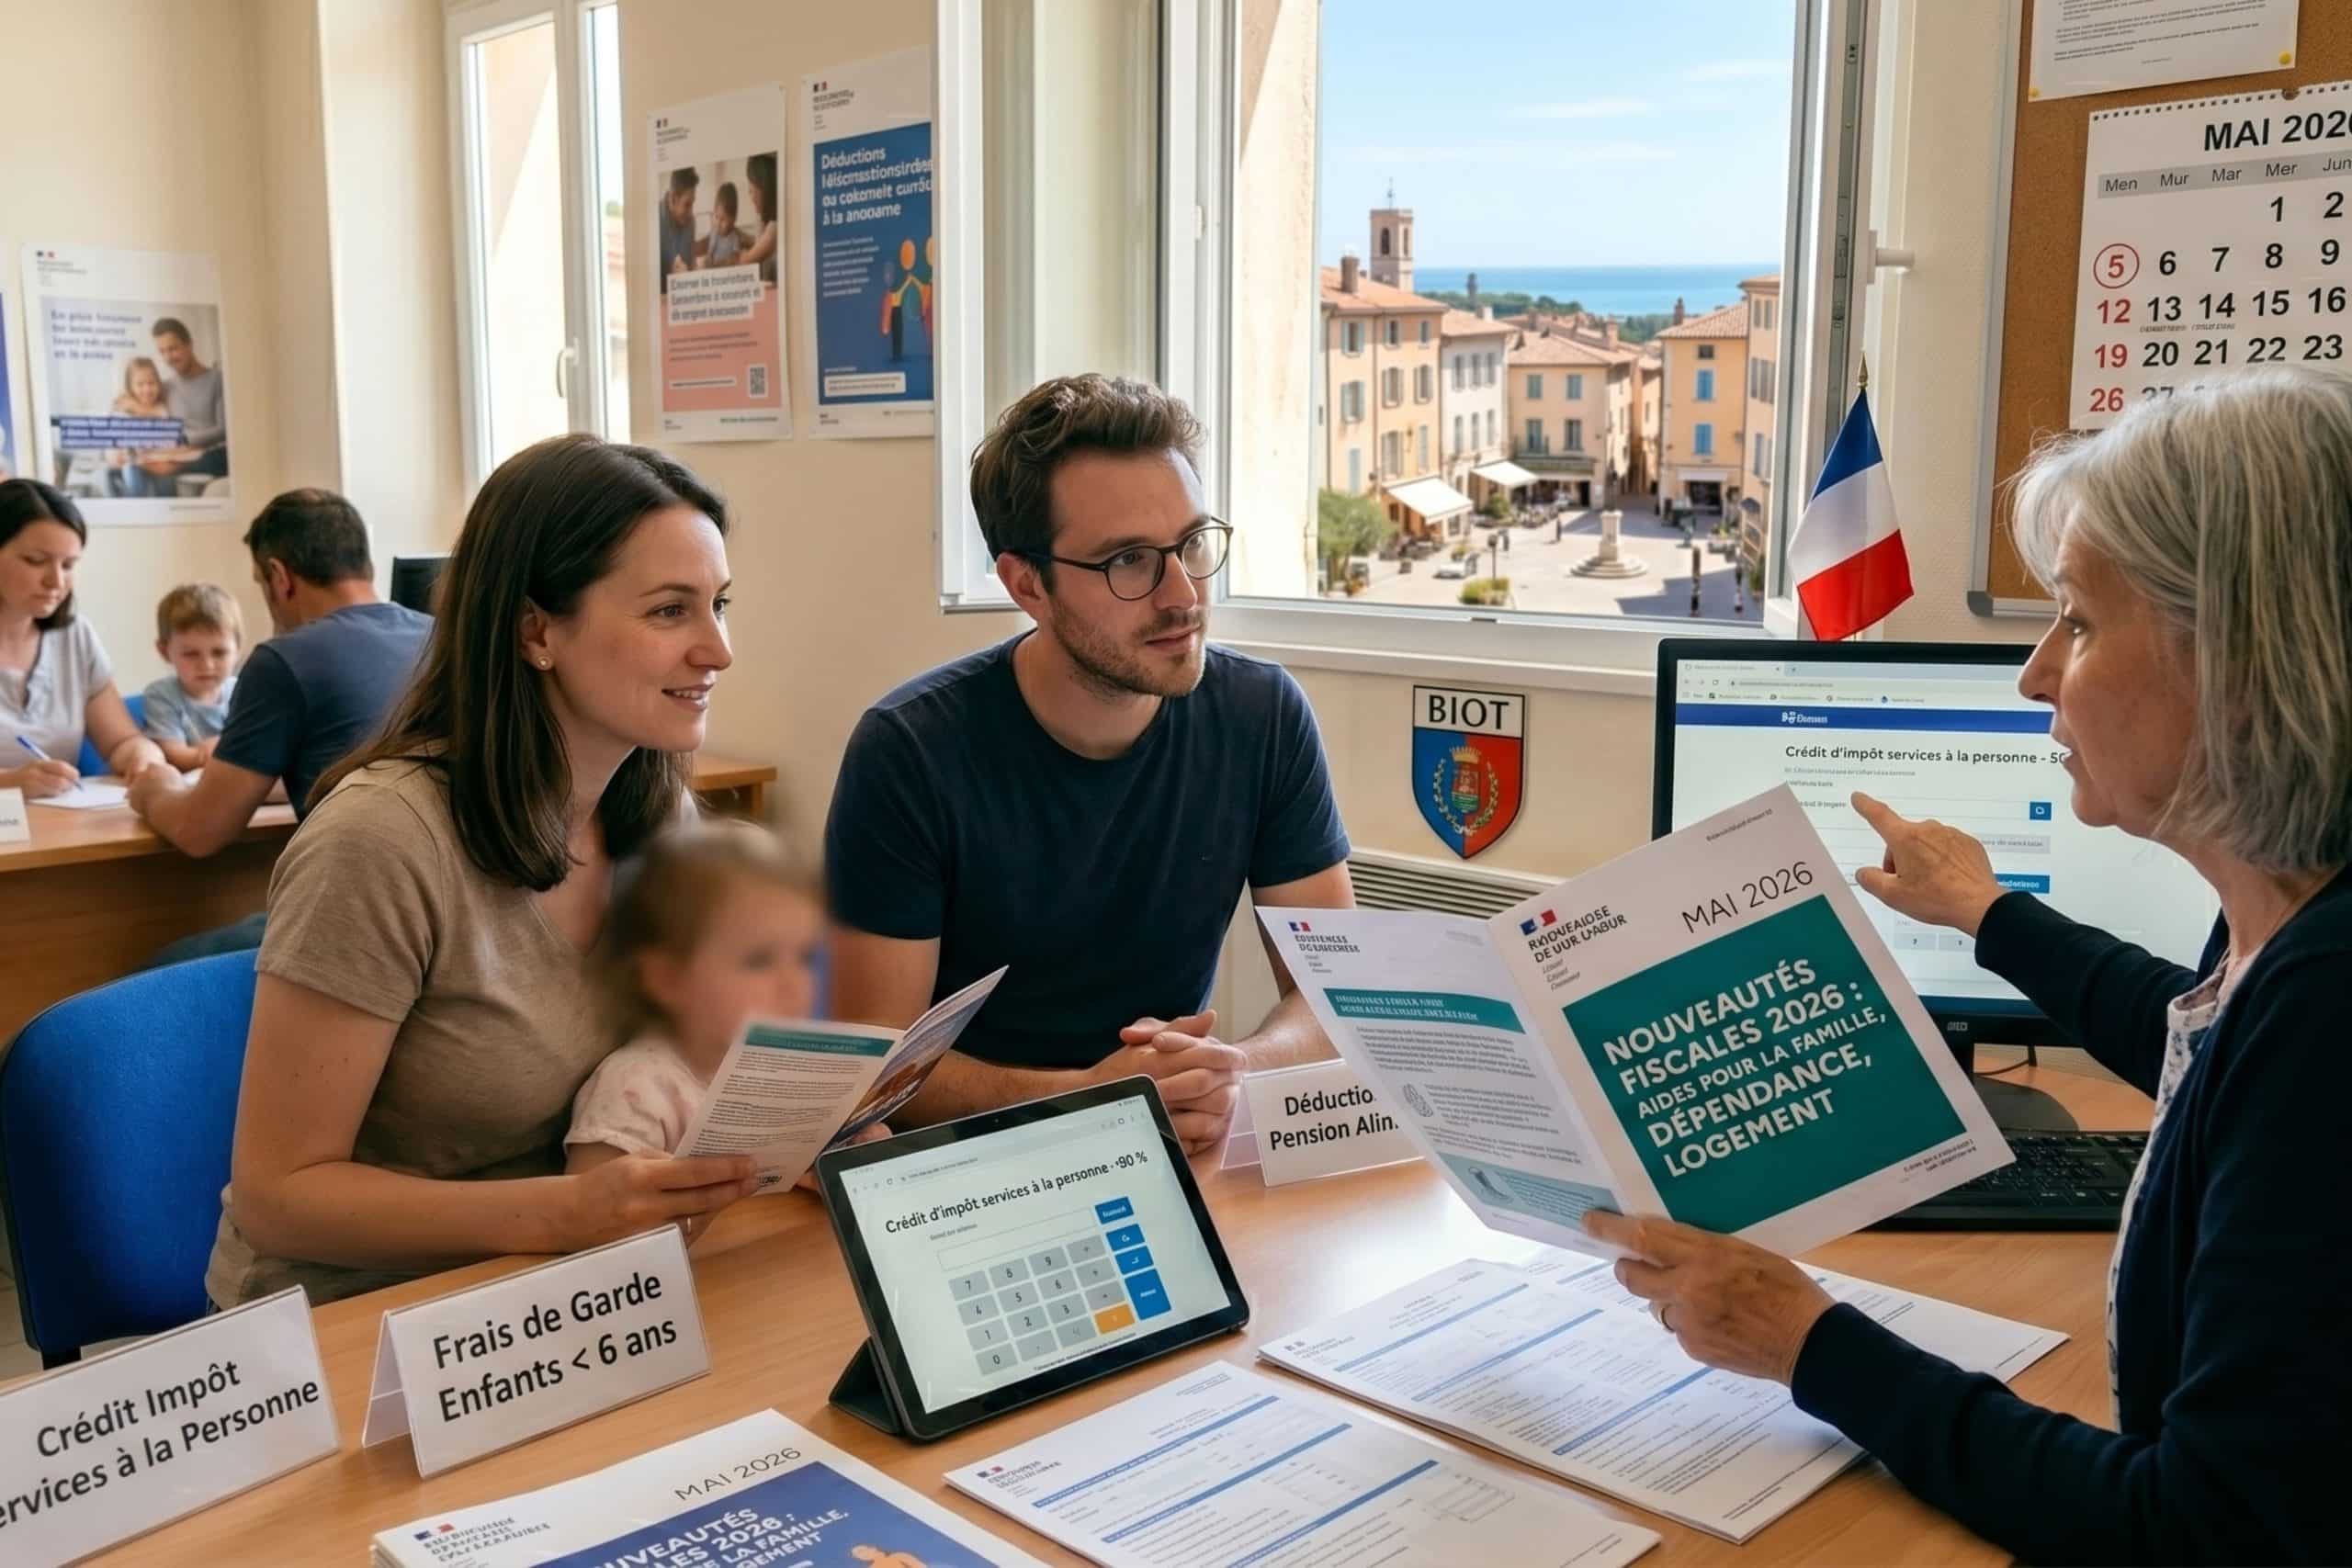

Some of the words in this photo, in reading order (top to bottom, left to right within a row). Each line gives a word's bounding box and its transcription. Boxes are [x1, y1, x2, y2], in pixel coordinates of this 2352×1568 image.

[2204, 118, 2269, 151] MAI
[2281, 110, 2352, 143] 202
[821, 147, 886, 169] Déductions
[2105, 178, 2138, 192] Men
[2160, 173, 2189, 187] Mur
[2211, 168, 2242, 182] Mar
[2266, 163, 2298, 176] Mer
[2270, 197, 2284, 222] 1
[2324, 191, 2344, 219] 2
[2108, 254, 2124, 278] 5
[2159, 250, 2177, 276] 6
[2211, 247, 2230, 272] 7
[2265, 243, 2283, 268] 8
[2321, 240, 2340, 265] 9
[2097, 299, 2131, 323] 12
[2147, 296, 2181, 321] 13
[2199, 292, 2234, 319] 14
[2253, 290, 2290, 317] 15
[2308, 287, 2346, 313] 16
[2095, 344, 2128, 368] 19
[2143, 341, 2179, 367] 20
[2194, 339, 2228, 366] 21
[2247, 337, 2286, 363] 22
[2302, 334, 2343, 360] 23
[2089, 387, 2123, 412] 26
[1429, 694, 1510, 729] BIOT
[1785, 746, 1826, 758] Crédit
[1830, 747, 1883, 761] d'impôt
[1887, 749, 1941, 761] services
[1946, 750, 1953, 761] à
[1957, 750, 1969, 762] la
[1973, 751, 2037, 764] personne
[1682, 893, 1738, 933] MAI
[1742, 862, 1813, 908] 2026
[1534, 947, 1553, 963] DE
[1603, 959, 1815, 1066] NOUVEAUTÉS
[1620, 1019, 1762, 1095] FISCALES
[1766, 984, 1844, 1034] 2026
[1637, 1082, 1697, 1119] AIDES
[1699, 1057, 1758, 1091] POUR
[1759, 1044, 1791, 1067] LA
[1792, 1006, 1886, 1055] FAMILLE,
[1284, 1086, 1375, 1116] Déductio
[1647, 1043, 1872, 1148] DÉPENDANCE,
[1270, 1122, 1351, 1151] Pension
[1663, 1088, 1835, 1178] LOGEMENT
[886, 1213, 928, 1234] Crédit
[930, 1197, 980, 1222] d'impôt
[982, 1186, 1030, 1208] services
[1032, 1179, 1041, 1194] à
[1041, 1177, 1054, 1191] la
[1056, 1163, 1110, 1190] personne
[1135, 1150, 1148, 1164] %
[1045, 1256, 1052, 1267] 9
[1015, 1292, 1023, 1303] 5
[434, 1320, 513, 1369] Frais
[523, 1304, 562, 1339] de
[571, 1272, 662, 1323] Garde
[1024, 1316, 1033, 1327] 2
[439, 1359, 563, 1422] Enfants
[571, 1348, 591, 1370] <
[598, 1334, 617, 1365] 6
[625, 1320, 677, 1357] ans
[993, 1354, 1001, 1365] 0
[37, 1400, 139, 1457] Crédit
[146, 1360, 241, 1416] Impôt
[116, 1448, 136, 1478] à
[143, 1438, 174, 1467] la
[181, 1381, 319, 1451] Personne
[675, 1473, 731, 1500] MAI
[734, 1448, 801, 1478] 2026
[711, 1517, 782, 1551] 2026
